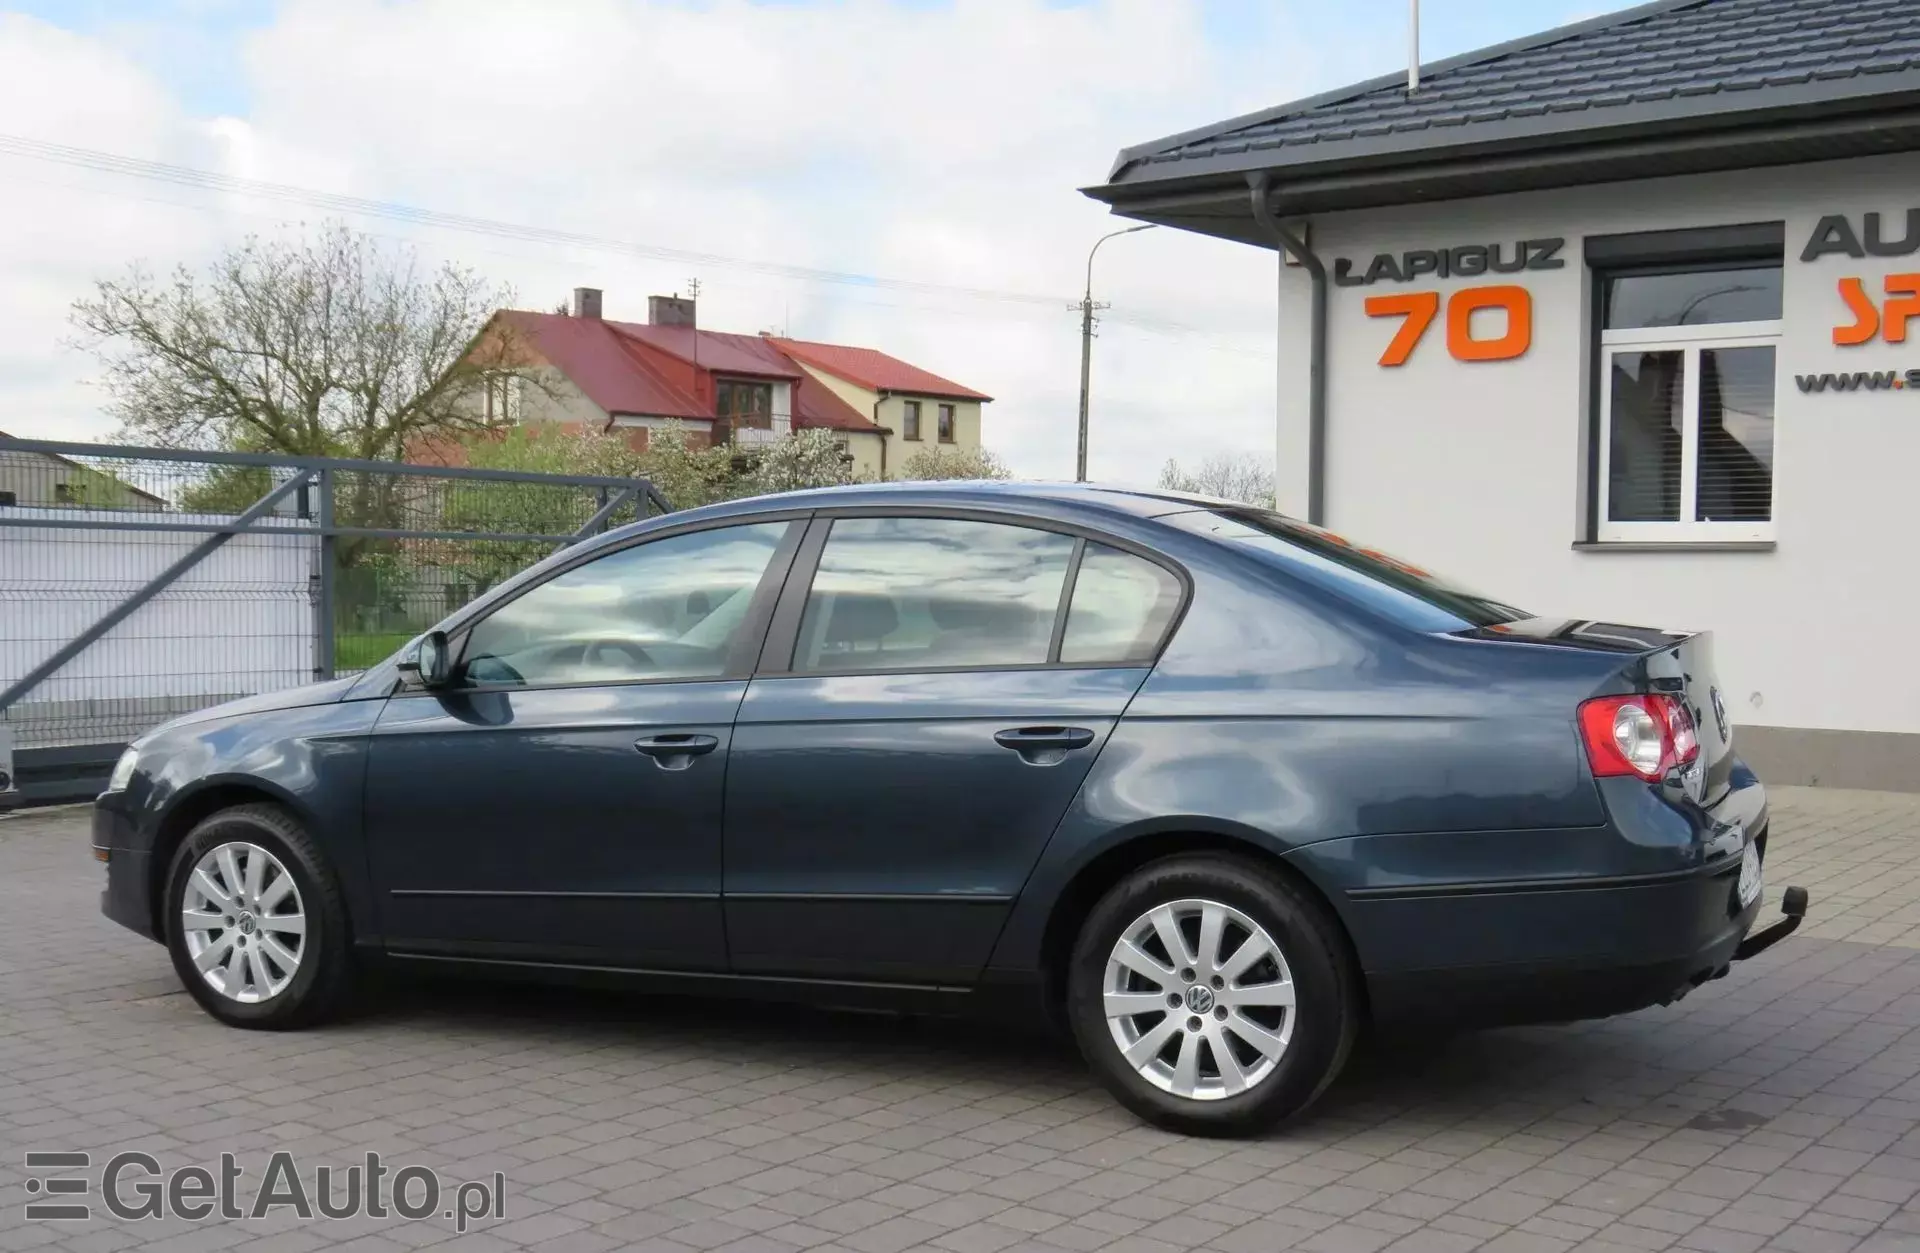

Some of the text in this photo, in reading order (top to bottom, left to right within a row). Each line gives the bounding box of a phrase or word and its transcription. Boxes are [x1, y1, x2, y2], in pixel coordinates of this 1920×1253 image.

[1800, 208, 1920, 262] AU
[1364, 285, 1532, 367] 70
[1832, 273, 1920, 346] SP
